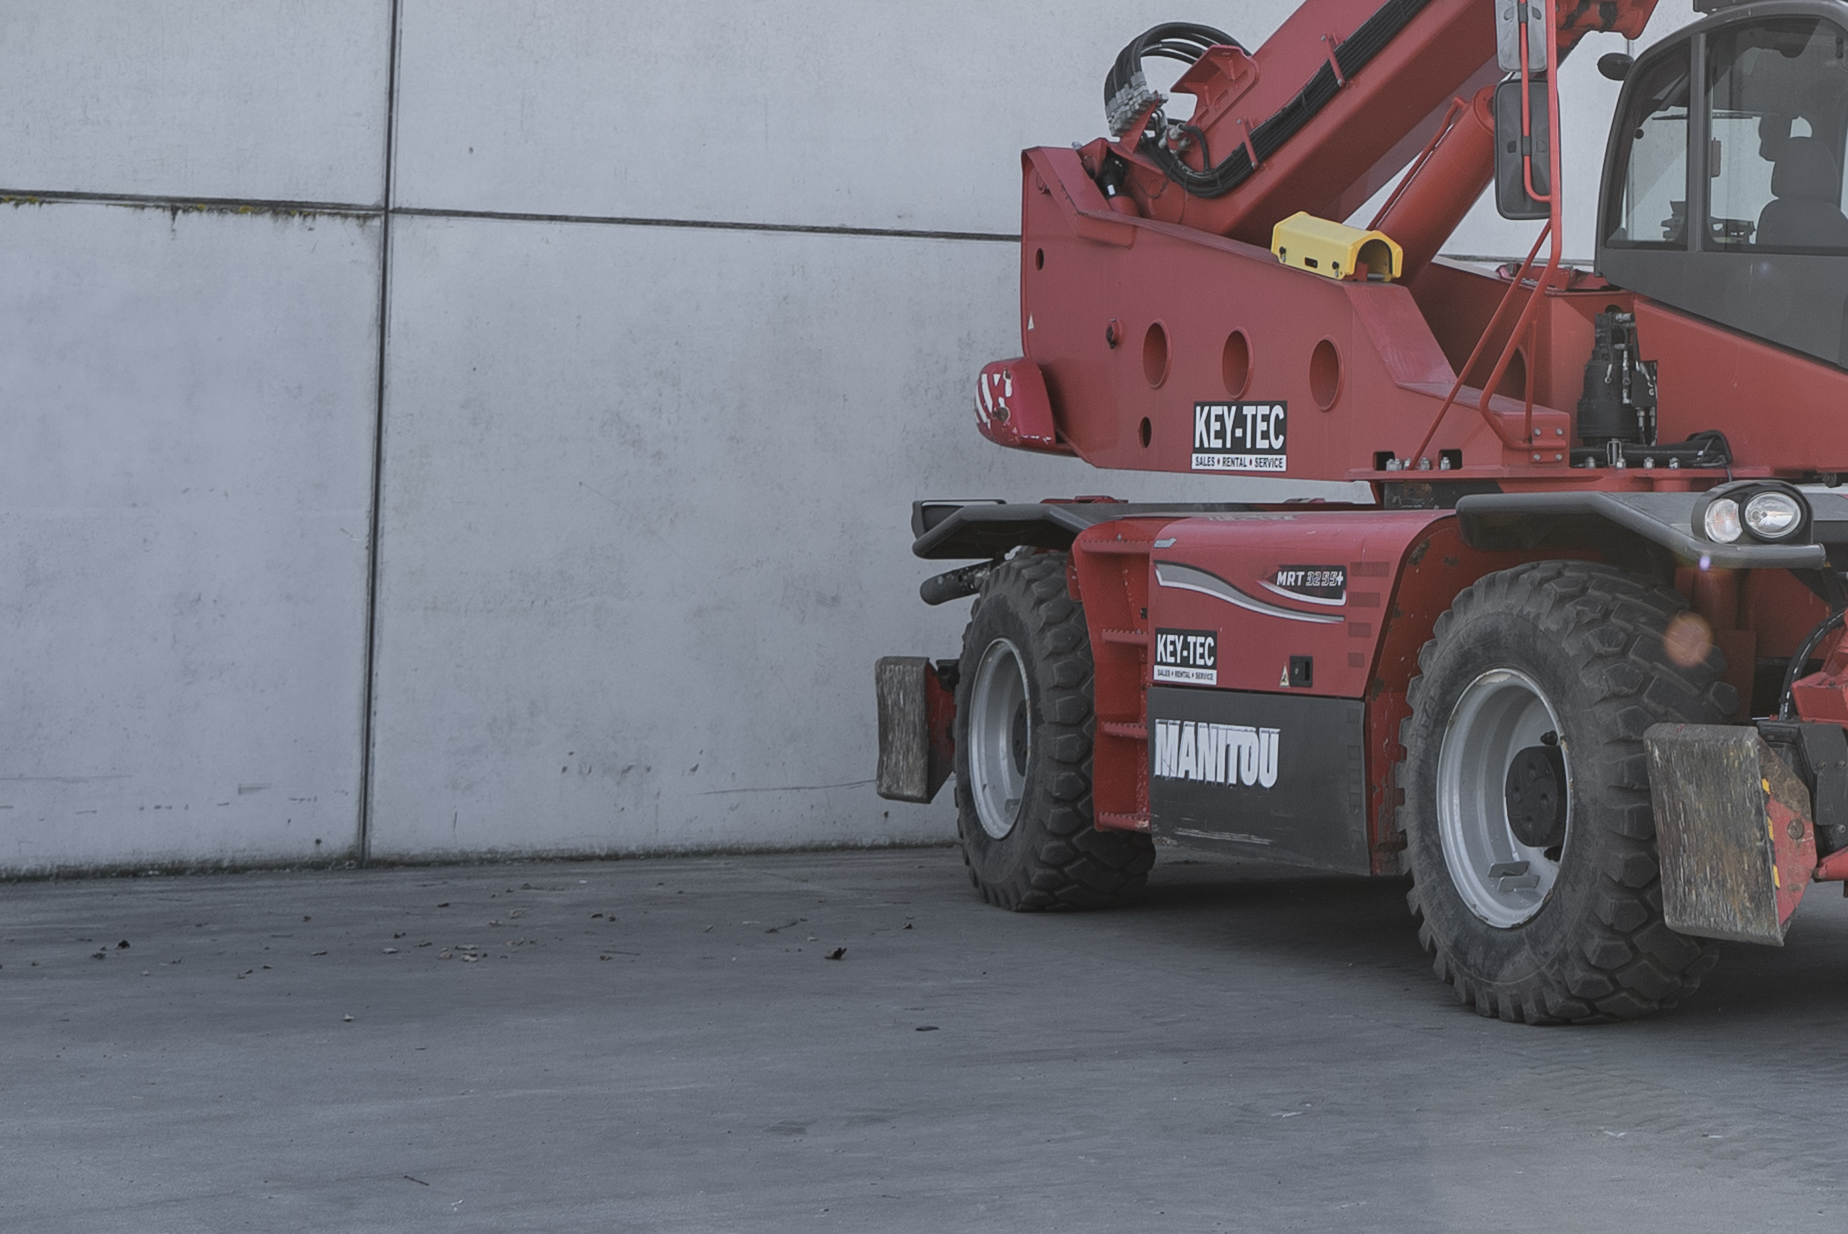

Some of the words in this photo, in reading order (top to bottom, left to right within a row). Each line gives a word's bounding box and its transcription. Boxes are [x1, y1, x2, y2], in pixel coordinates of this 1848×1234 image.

[1195, 405, 1285, 450] KEY-TEC
[1195, 456, 1215, 467] SALES
[1222, 457, 1247, 468] RENTAL
[1254, 457, 1283, 469] SERVICE
[1276, 570, 1305, 586] MRT
[1157, 634, 1215, 666] KEY-TEC
[1154, 718, 1281, 788] MANITOU
